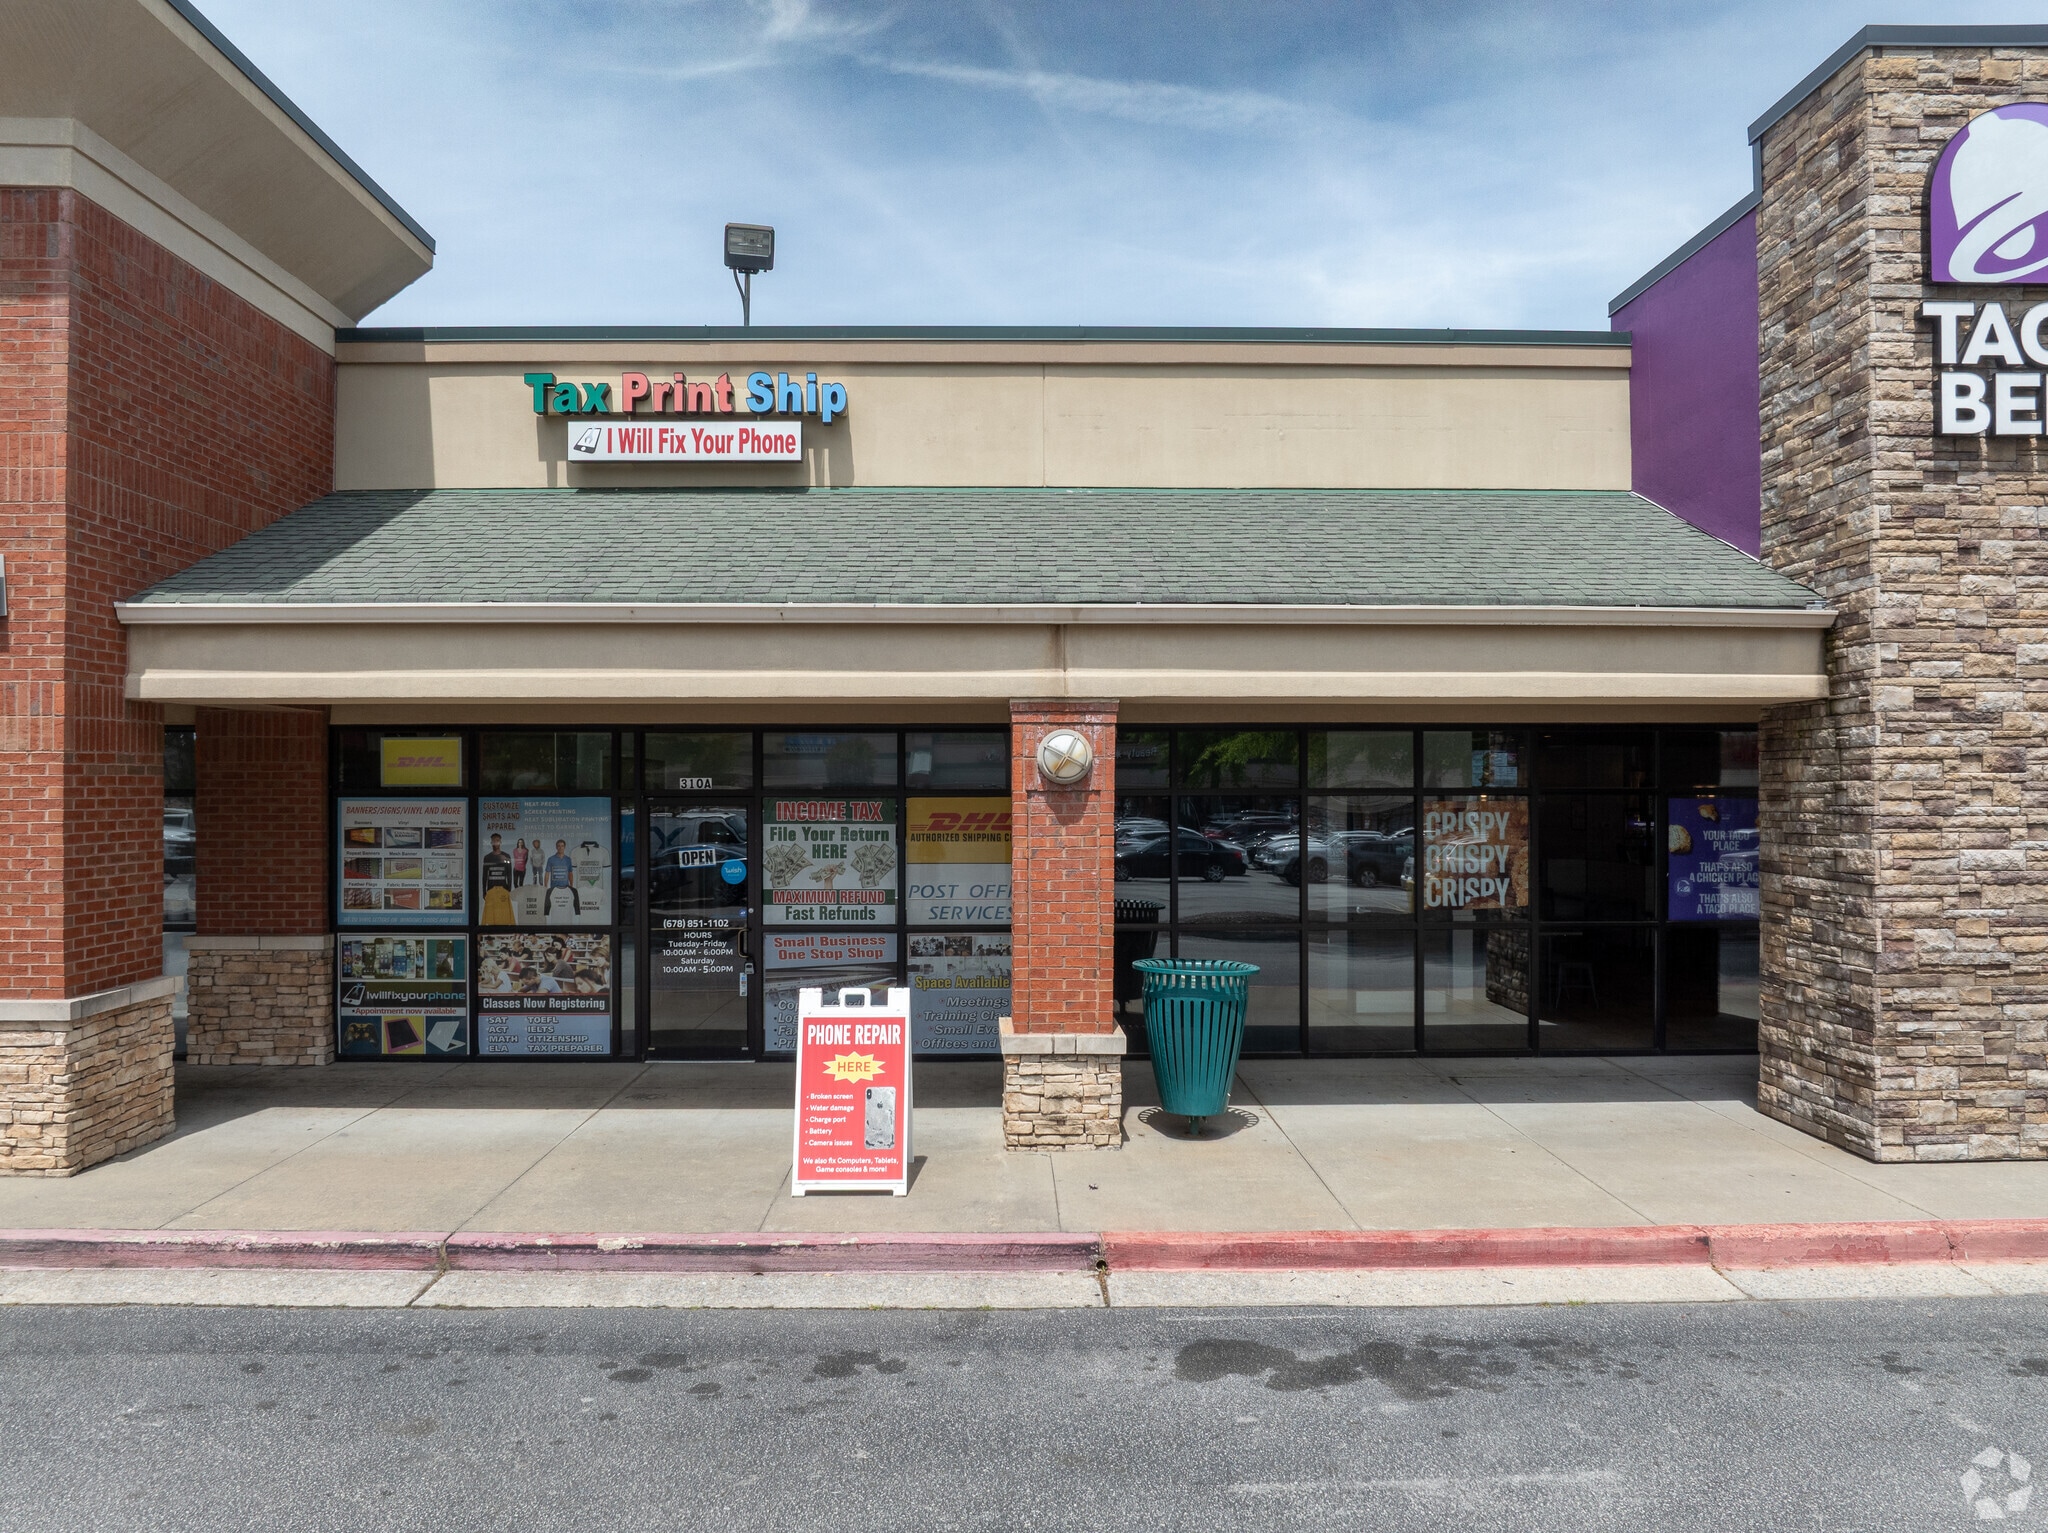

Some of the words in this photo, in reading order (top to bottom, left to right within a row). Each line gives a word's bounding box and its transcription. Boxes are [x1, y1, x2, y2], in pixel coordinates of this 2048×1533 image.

[524, 373, 611, 414] Tax
[622, 372, 735, 414] Print
[746, 372, 847, 425] Ship
[1942, 372, 2048, 435] BE
[607, 428, 613, 454] I
[618, 428, 652, 454] Will
[659, 428, 686, 454] Fix
[691, 428, 735, 454] Your
[739, 428, 796, 454] Phone
[398, 757, 446, 768] DHL
[681, 779, 711, 789] 310A
[346, 806, 423, 815] BANNERS/SIGNS/VINYL
[424, 807, 437, 815] AND
[440, 807, 461, 815] MORE
[483, 802, 519, 810] CUSTOMIZE
[776, 801, 846, 821] INCOME
[850, 801, 883, 821] TAX
[927, 813, 1012, 831] DHL
[1426, 812, 1510, 841] CRISPY
[770, 827, 796, 841] File
[802, 827, 836, 841] Your
[841, 827, 890, 841] Return
[910, 833, 960, 842] AUTHORIZED
[963, 833, 1001, 842] SHIPPING
[1703, 830, 1728, 841] YOUR
[1729, 830, 1750, 841] TACO
[812, 844, 847, 859] HERE
[1713, 841, 1740, 851] PLACE
[682, 850, 713, 866] OPEN
[1426, 844, 1510, 874] CRISPY
[1699, 862, 1729, 872] THAT'S
[1733, 862, 1753, 872] ALSO
[1690, 873, 1695, 882] A
[1697, 873, 1734, 882] CHICKEN
[909, 885, 959, 898] POST
[1426, 878, 1510, 907] CRISPY
[773, 890, 836, 905] MAXIMUM
[839, 890, 885, 905] REFUND
[1699, 894, 1729, 904] THAT'S
[1732, 894, 1753, 904] ALSO
[786, 906, 814, 920] Fast
[820, 906, 876, 920] Refunds
[1697, 904, 1703, 914] A
[1705, 904, 1727, 914] TACO
[1729, 904, 1756, 914] PLACE
[663, 919, 686, 928] (678)
[687, 919, 729, 927] 851-1102
[774, 937, 814, 948] Small
[820, 936, 886, 946] Business
[779, 950, 806, 960] One
[811, 949, 843, 960] Stop
[848, 948, 883, 959] Shop
[916, 976, 952, 991] Space
[955, 975, 1010, 989] Available
[483, 998, 520, 1008] Classes
[524, 998, 546, 1008] Now
[549, 998, 605, 1010] Registering
[946, 997, 1009, 1009] Meetings
[488, 1016, 508, 1024] SAT
[527, 1016, 559, 1024] TOEFL
[924, 1011, 977, 1022] Training
[808, 1024, 852, 1045] PHONE
[855, 1024, 901, 1045] REPAIR
[934, 1024, 973, 1034] Small
[488, 1035, 519, 1043] MATH
[527, 1035, 589, 1043] CITIZENSHIP
[921, 1039, 968, 1048] Offices
[971, 1039, 997, 1048] and
[838, 1062, 871, 1072] HERE
[810, 1116, 832, 1124] Charge
[837, 1157, 873, 1165] Computers,
[874, 1157, 899, 1165] Tablets,
